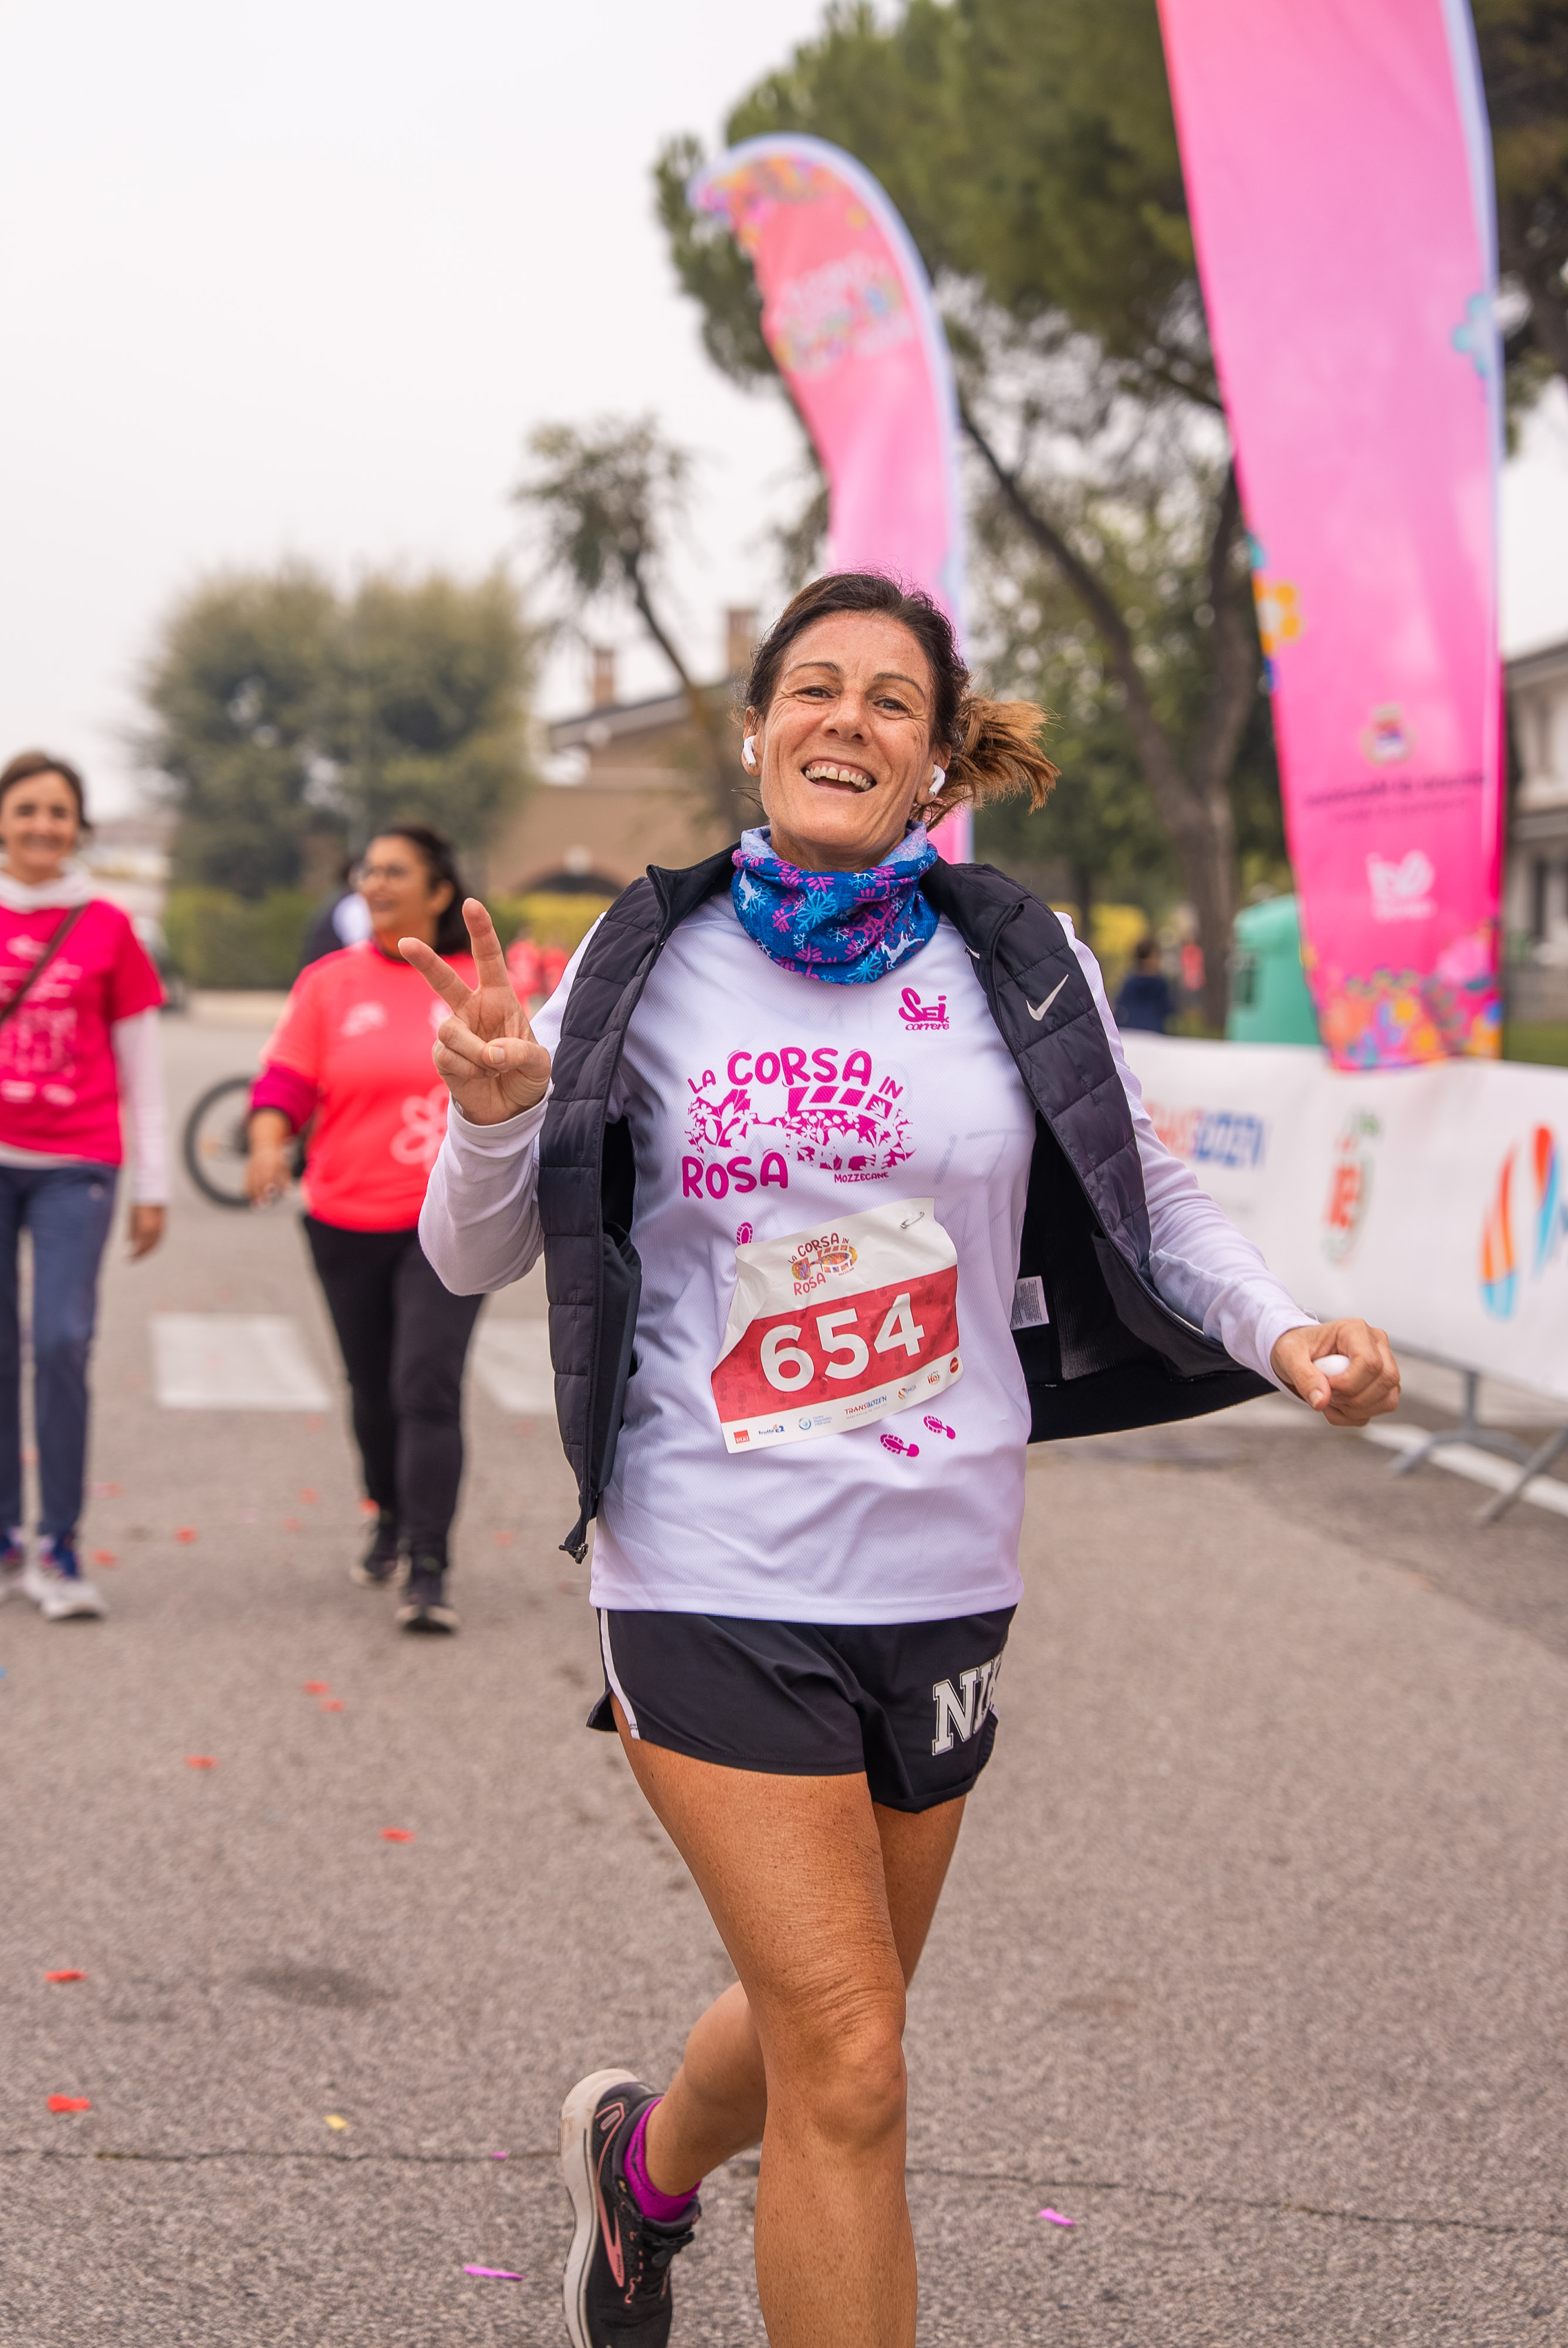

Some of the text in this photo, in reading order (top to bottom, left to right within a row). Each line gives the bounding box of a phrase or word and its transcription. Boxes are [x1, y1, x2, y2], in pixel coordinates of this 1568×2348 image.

[687, 1047, 904, 1099] LA CORSA IN
[682, 1151, 789, 1199] ROSA
[834, 1172, 889, 1183] MOZZECANE
[788, 1256, 797, 1264] LA
[797, 1233, 839, 1257] CORSA
[793, 1272, 826, 1296] ROSA
[760, 1292, 925, 1392] 654
